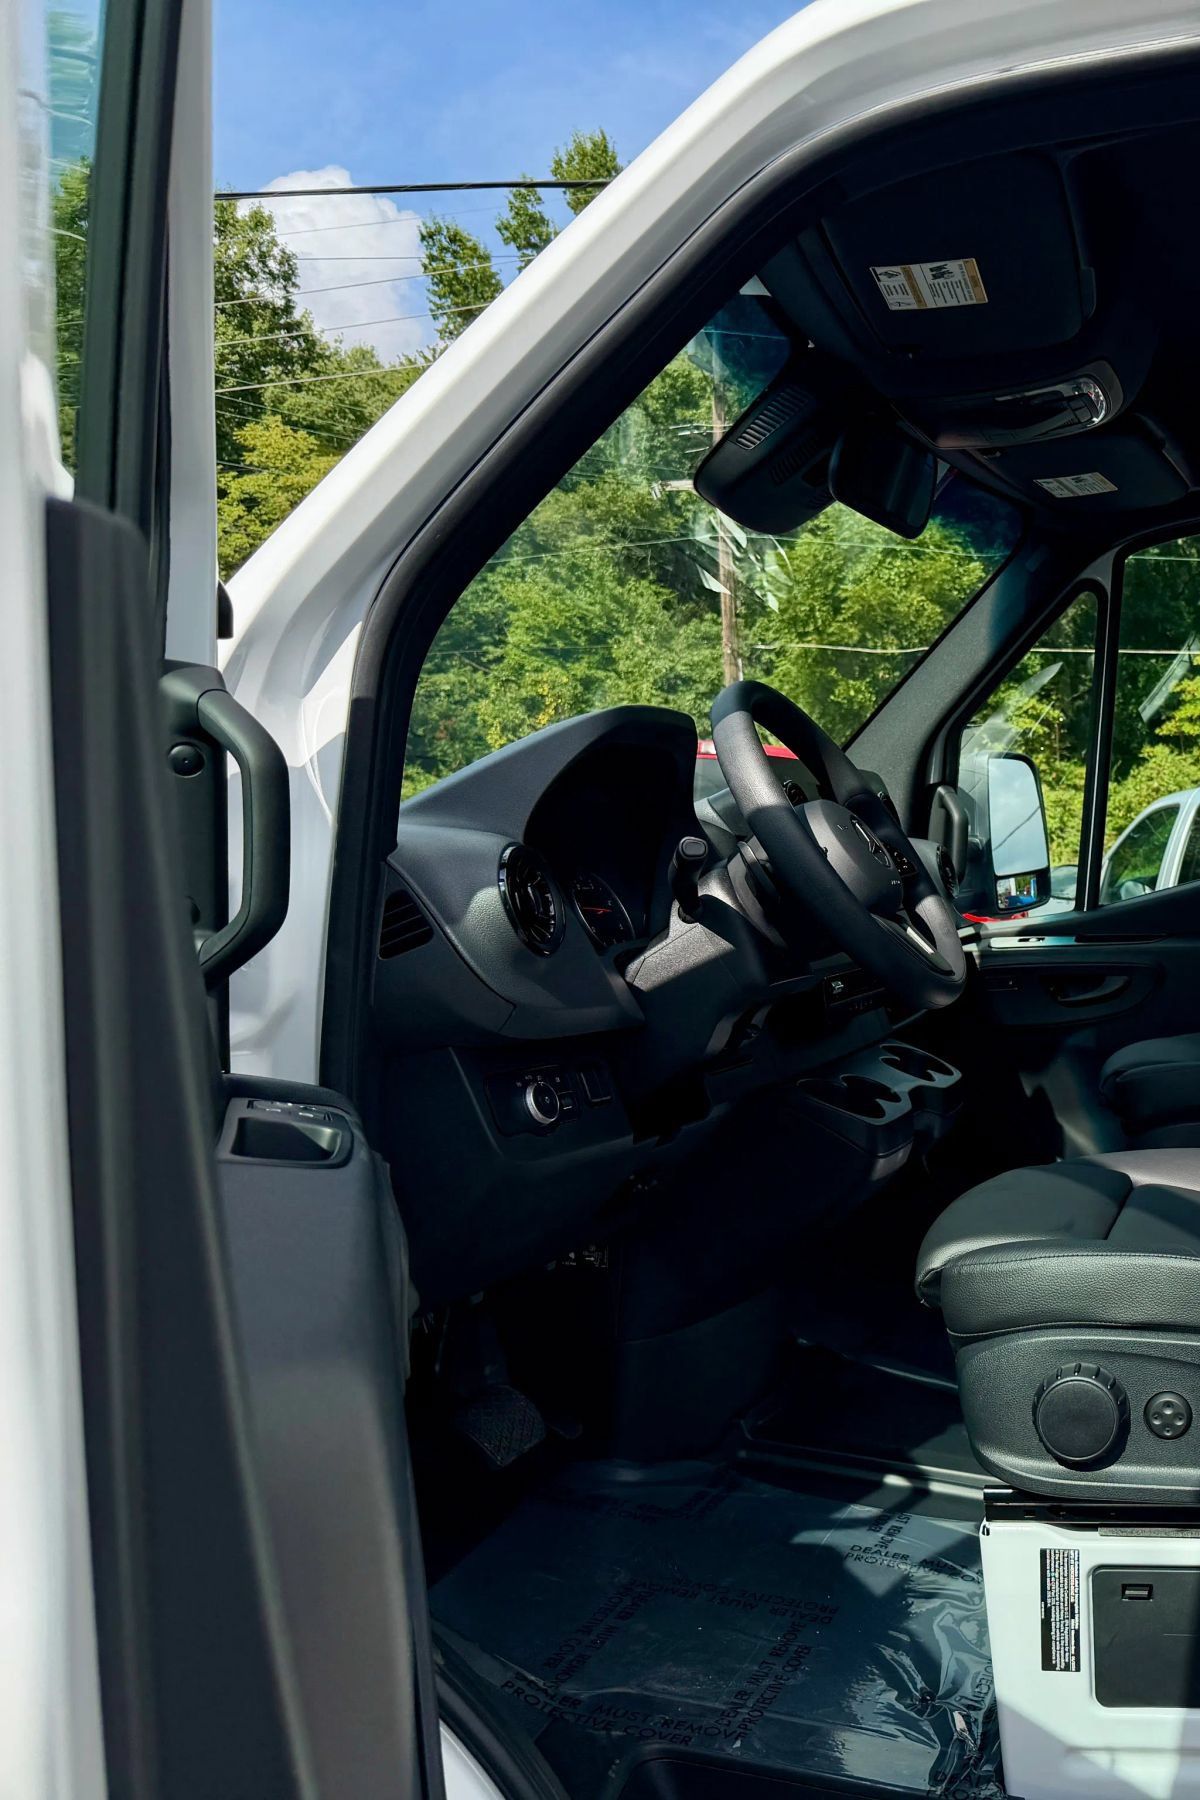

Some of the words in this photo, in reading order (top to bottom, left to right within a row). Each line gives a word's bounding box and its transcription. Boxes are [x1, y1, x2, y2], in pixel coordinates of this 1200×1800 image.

[850, 1544, 910, 1561] DEALER
[738, 1590, 840, 1615] PROTECTIVE
[768, 1605, 834, 1625] DEALER
[515, 1671, 582, 1711] DEALER
[593, 1703, 654, 1724] MUST
[655, 1715, 747, 1744] REMOVE
[716, 1688, 753, 1727] DEALER
[748, 1659, 777, 1687] MUST
[769, 1621, 807, 1657] REMOVE
[738, 1674, 790, 1739] PROTECTIVE
[782, 1644, 813, 1673] COVER
[501, 1680, 614, 1733] PROTECTIVE
[624, 1723, 693, 1747] COVER
